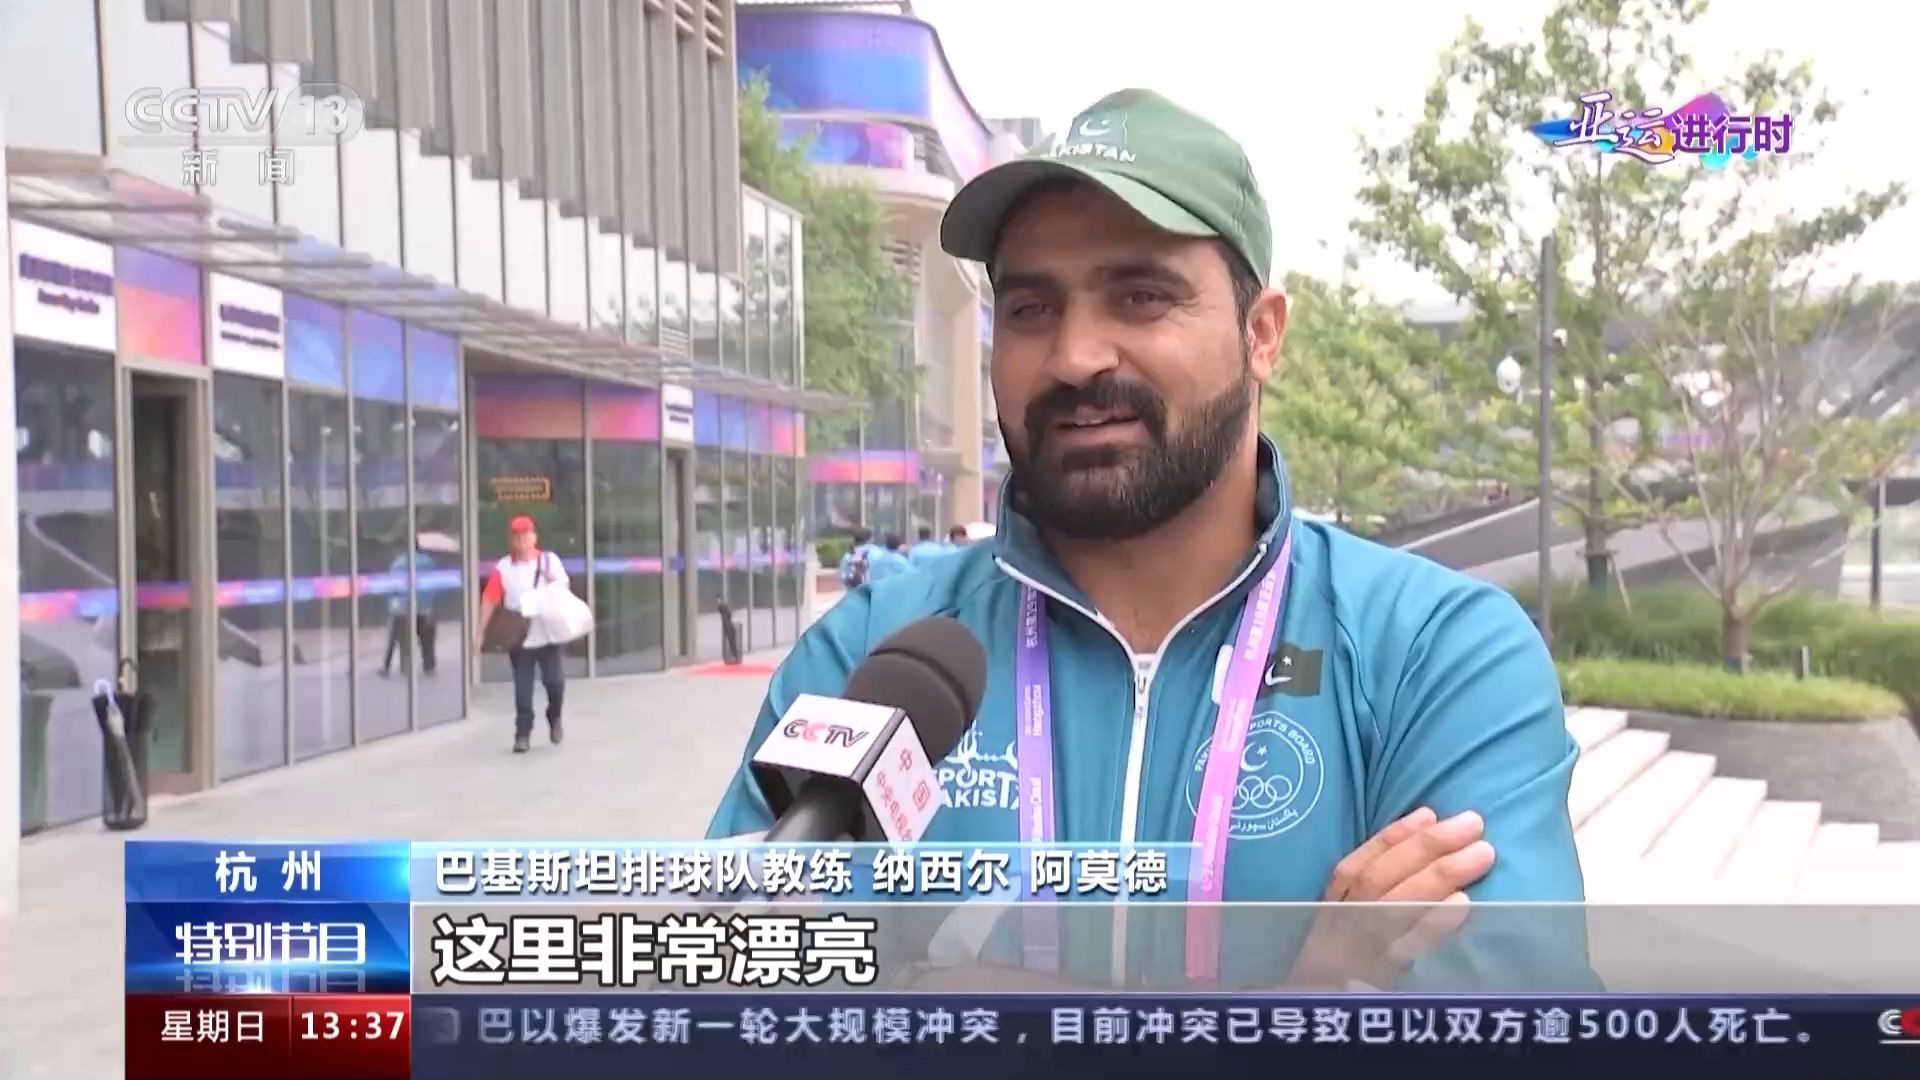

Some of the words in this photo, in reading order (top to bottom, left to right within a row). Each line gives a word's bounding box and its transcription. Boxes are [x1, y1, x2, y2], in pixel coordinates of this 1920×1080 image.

[783, 718, 869, 749] CCTV
[1248, 717, 1288, 733] PORTS
[1287, 728, 1316, 765] BOARD
